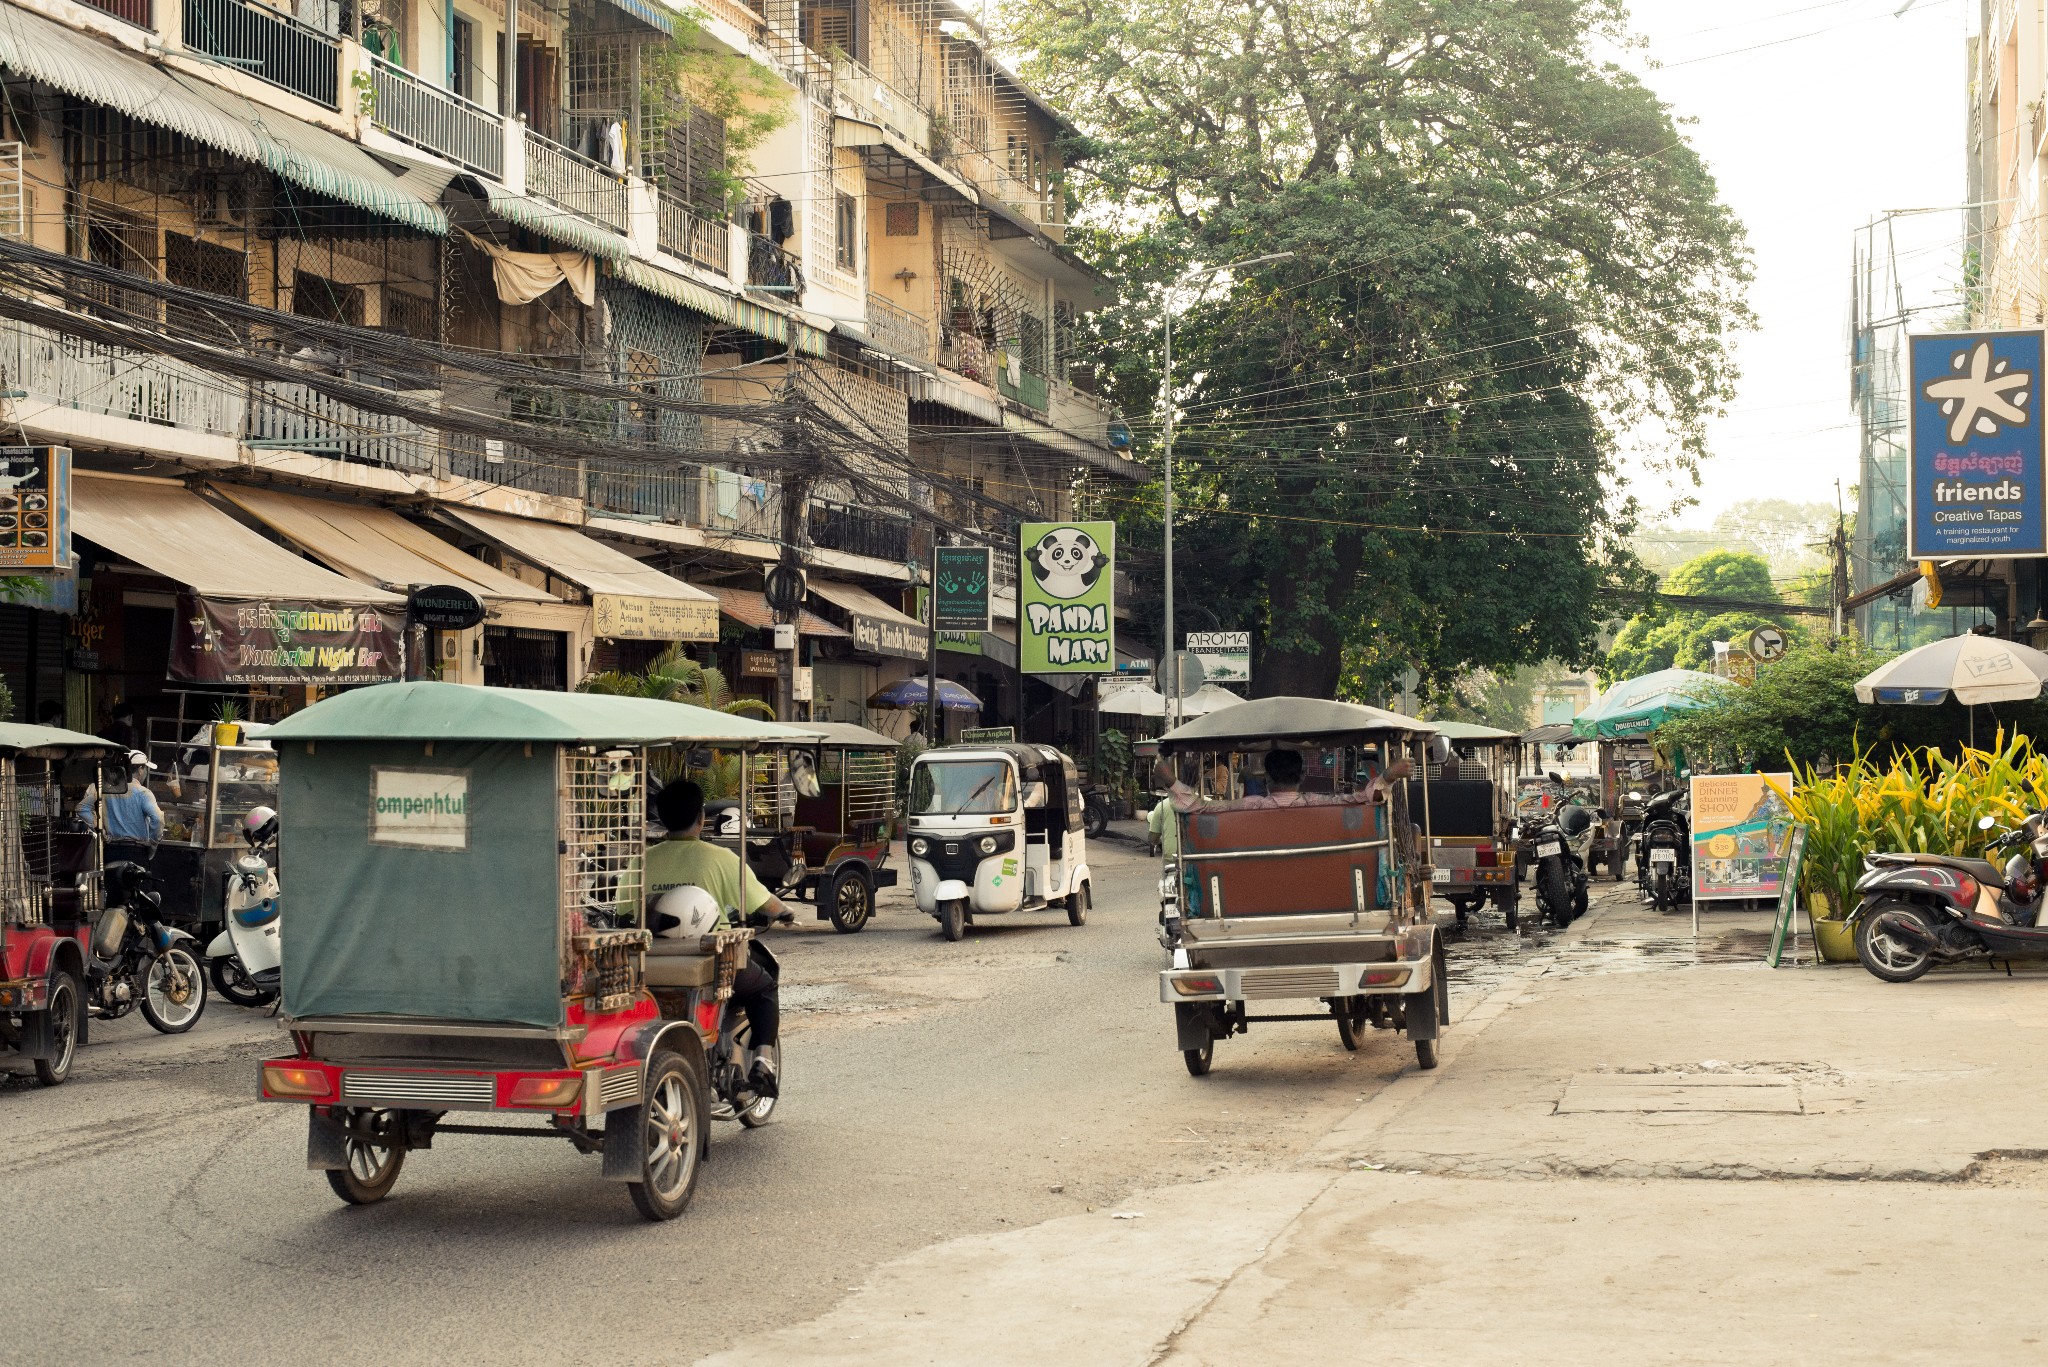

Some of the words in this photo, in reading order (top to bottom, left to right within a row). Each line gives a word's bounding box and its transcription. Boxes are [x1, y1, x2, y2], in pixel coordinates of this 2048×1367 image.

[1936, 480, 2021, 502] friends
[1935, 510, 1984, 522] Creative
[1987, 509, 2022, 522] Tapas
[1936, 528, 1942, 536] A
[1943, 528, 1970, 536] training
[1946, 536, 1990, 544] marginalized
[1991, 535, 2011, 544] youth
[416, 598, 474, 610] WONDERFUL
[424, 614, 446, 622] NIGHT
[448, 615, 464, 623] BAR
[620, 611, 643, 624] Artisans
[1026, 602, 1108, 636] PANDA
[70, 616, 105, 650] Tiger
[619, 624, 643, 637] Cambodia
[881, 623, 902, 649] Hands
[1188, 632, 1249, 646] AROMA
[1048, 636, 1109, 665] MART
[240, 645, 315, 666] Wonderful
[317, 647, 355, 671] Night
[357, 647, 383, 666] Bar
[1130, 660, 1149, 668] ATM
[1615, 718, 1650, 731] DOUBLEMINT
[986, 730, 1011, 739] Angkor
[1699, 788, 1738, 796] DINNER
[1699, 796, 1739, 804] stunning
[1699, 804, 1738, 813] SHOW
[1714, 843, 1729, 851] $30
